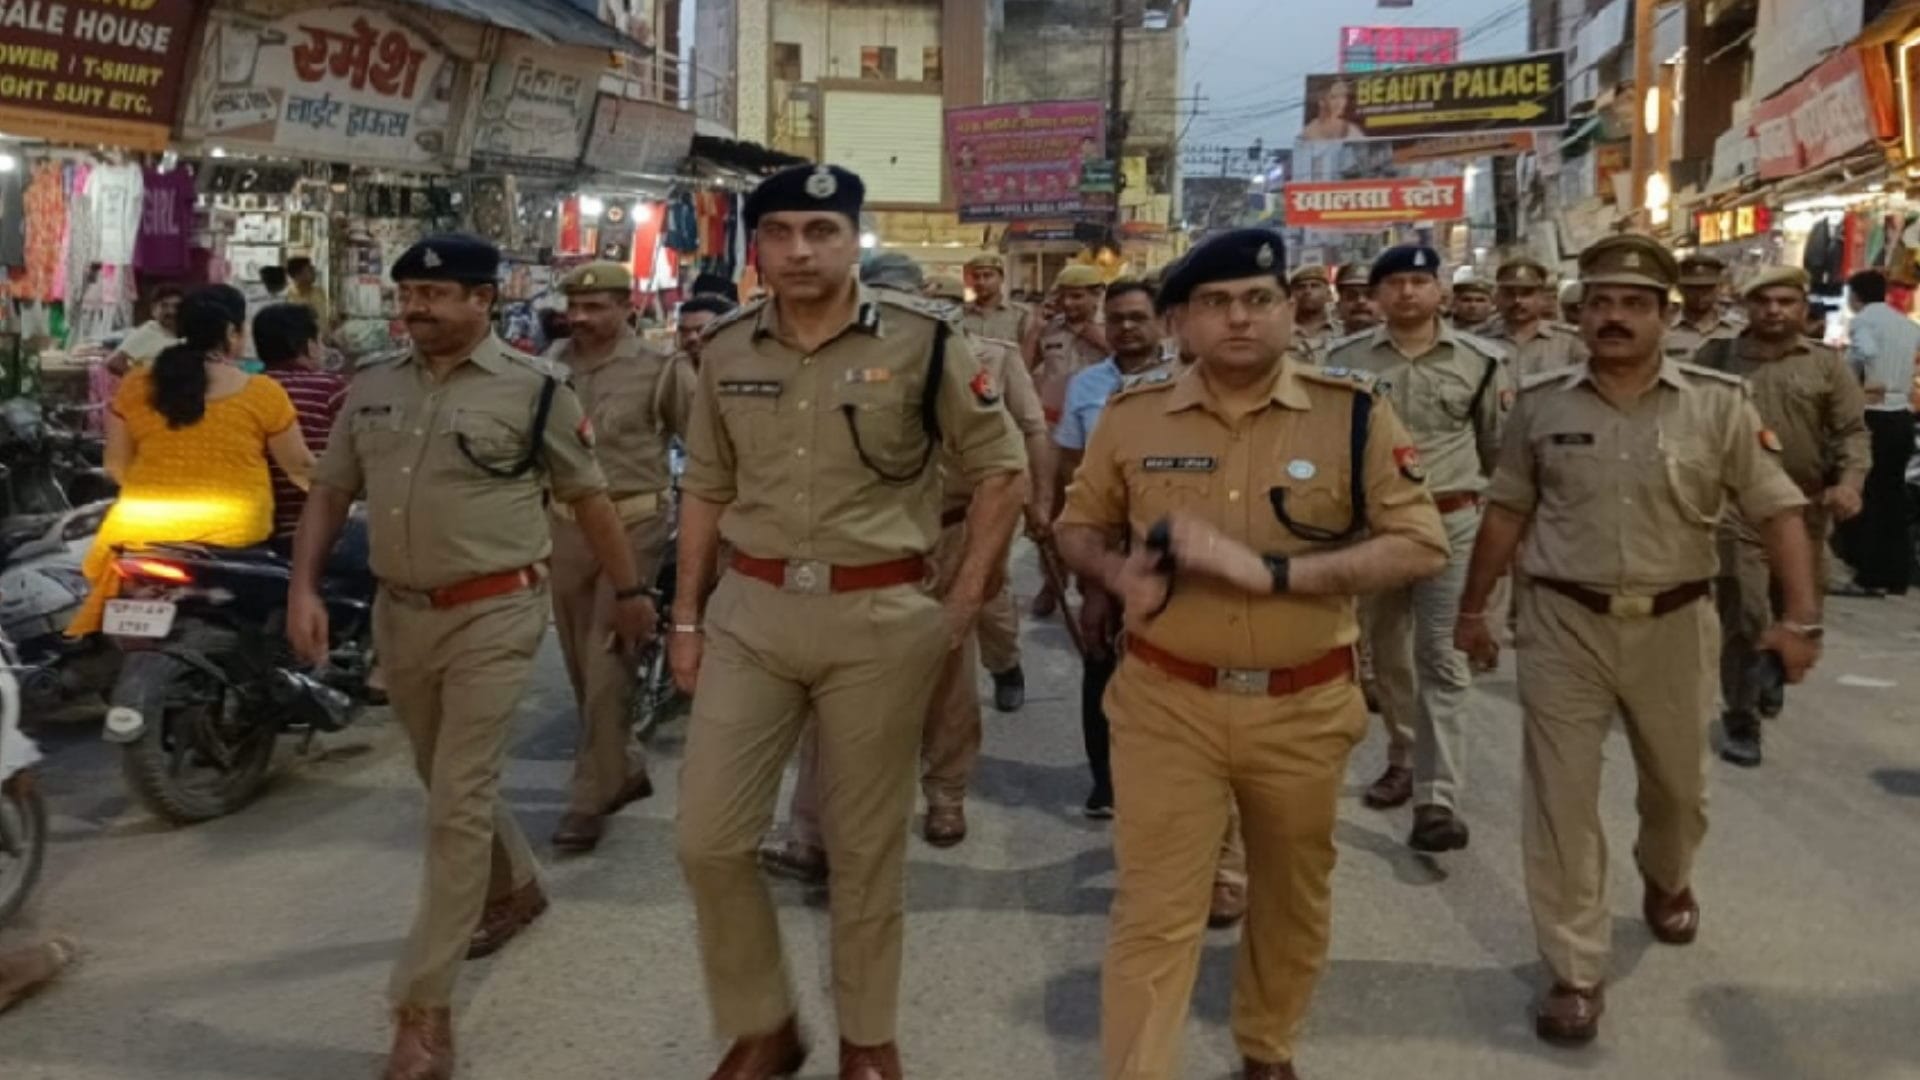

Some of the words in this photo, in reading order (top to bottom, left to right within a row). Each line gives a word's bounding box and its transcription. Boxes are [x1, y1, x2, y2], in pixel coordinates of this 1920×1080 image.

[74, 8, 173, 53] HOUSE
[83, 56, 163, 86] T-SHIRT
[292, 16, 427, 99] रमेश
[53, 81, 104, 106] SUIT
[108, 90, 153, 114] ETC.
[1356, 72, 1448, 105] BEAUTY
[1453, 63, 1550, 99] PALACE
[285, 92, 343, 129] लाईट
[1291, 187, 1392, 211] खालसा
[1400, 179, 1456, 206] स्टोर
